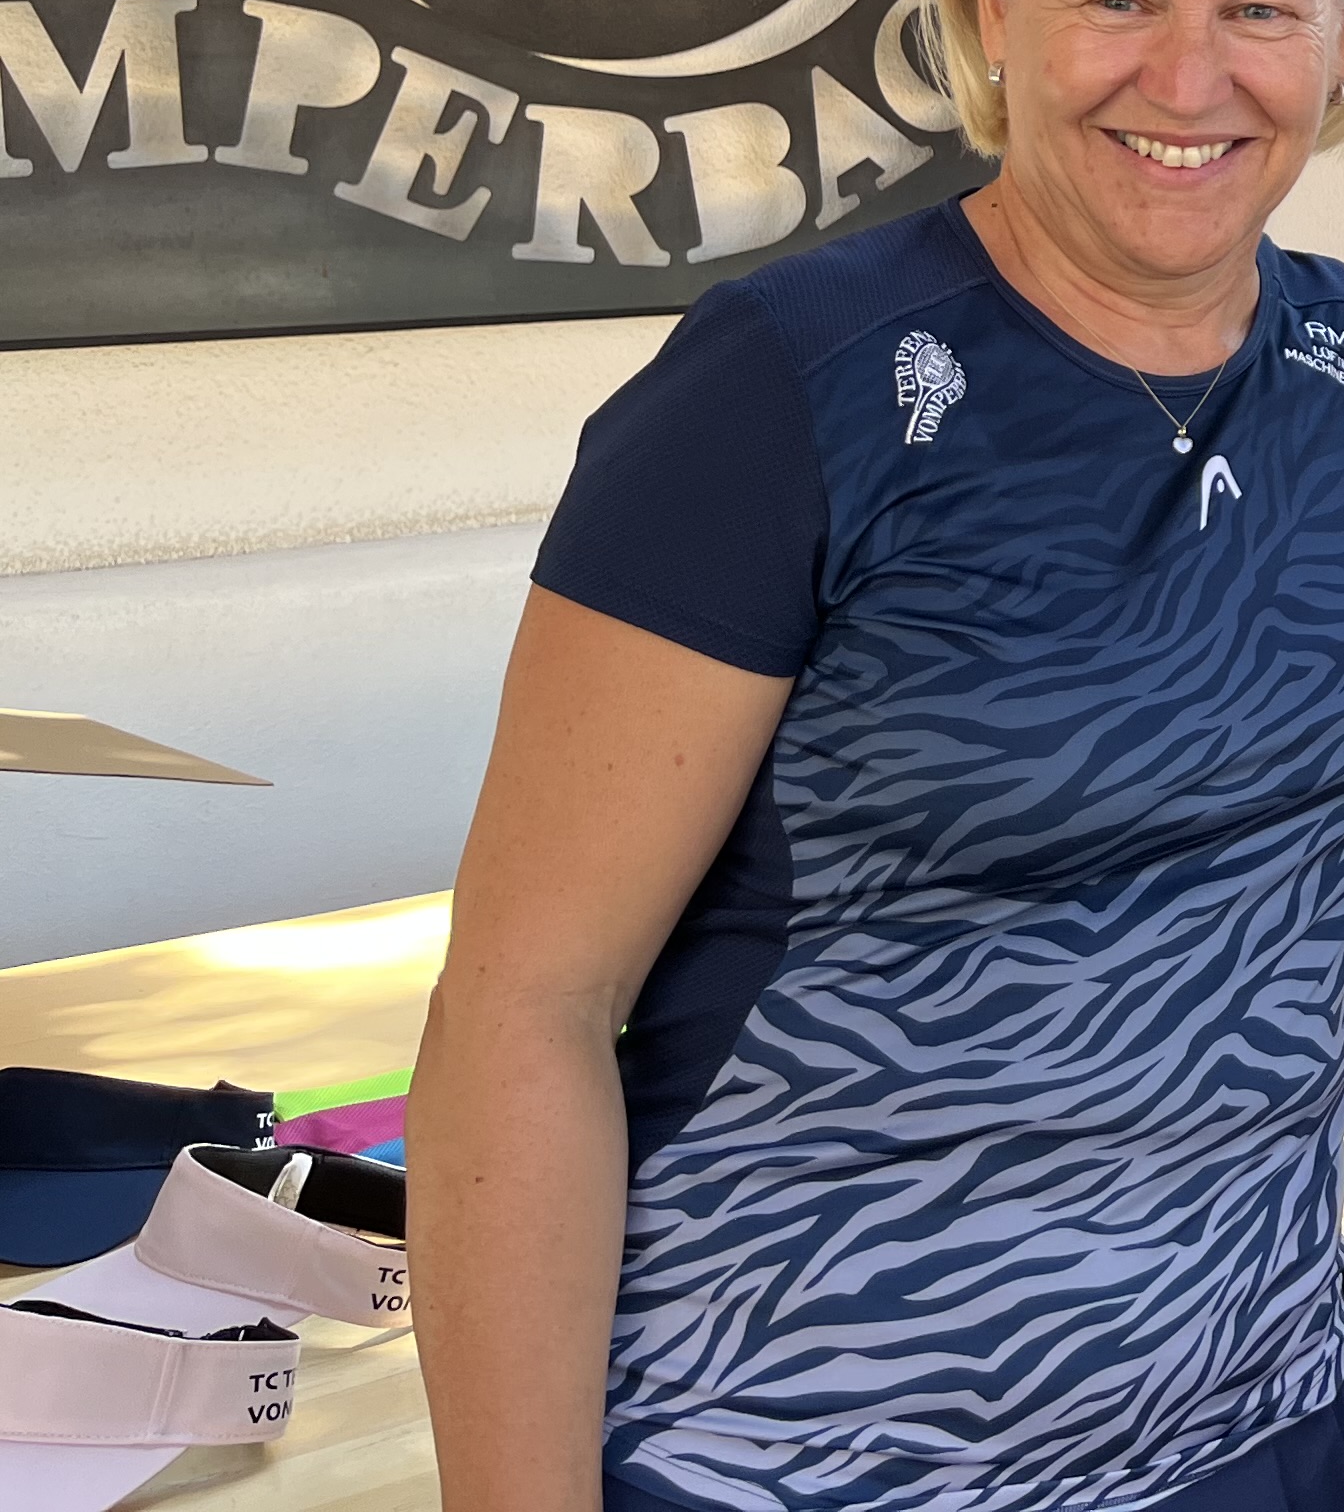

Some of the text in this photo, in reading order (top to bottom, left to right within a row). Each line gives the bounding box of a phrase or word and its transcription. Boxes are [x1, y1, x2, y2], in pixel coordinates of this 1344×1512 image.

[895, 329, 937, 407] TERFENS
[378, 1267, 407, 1285] TC
[249, 1368, 295, 1393] TC T
